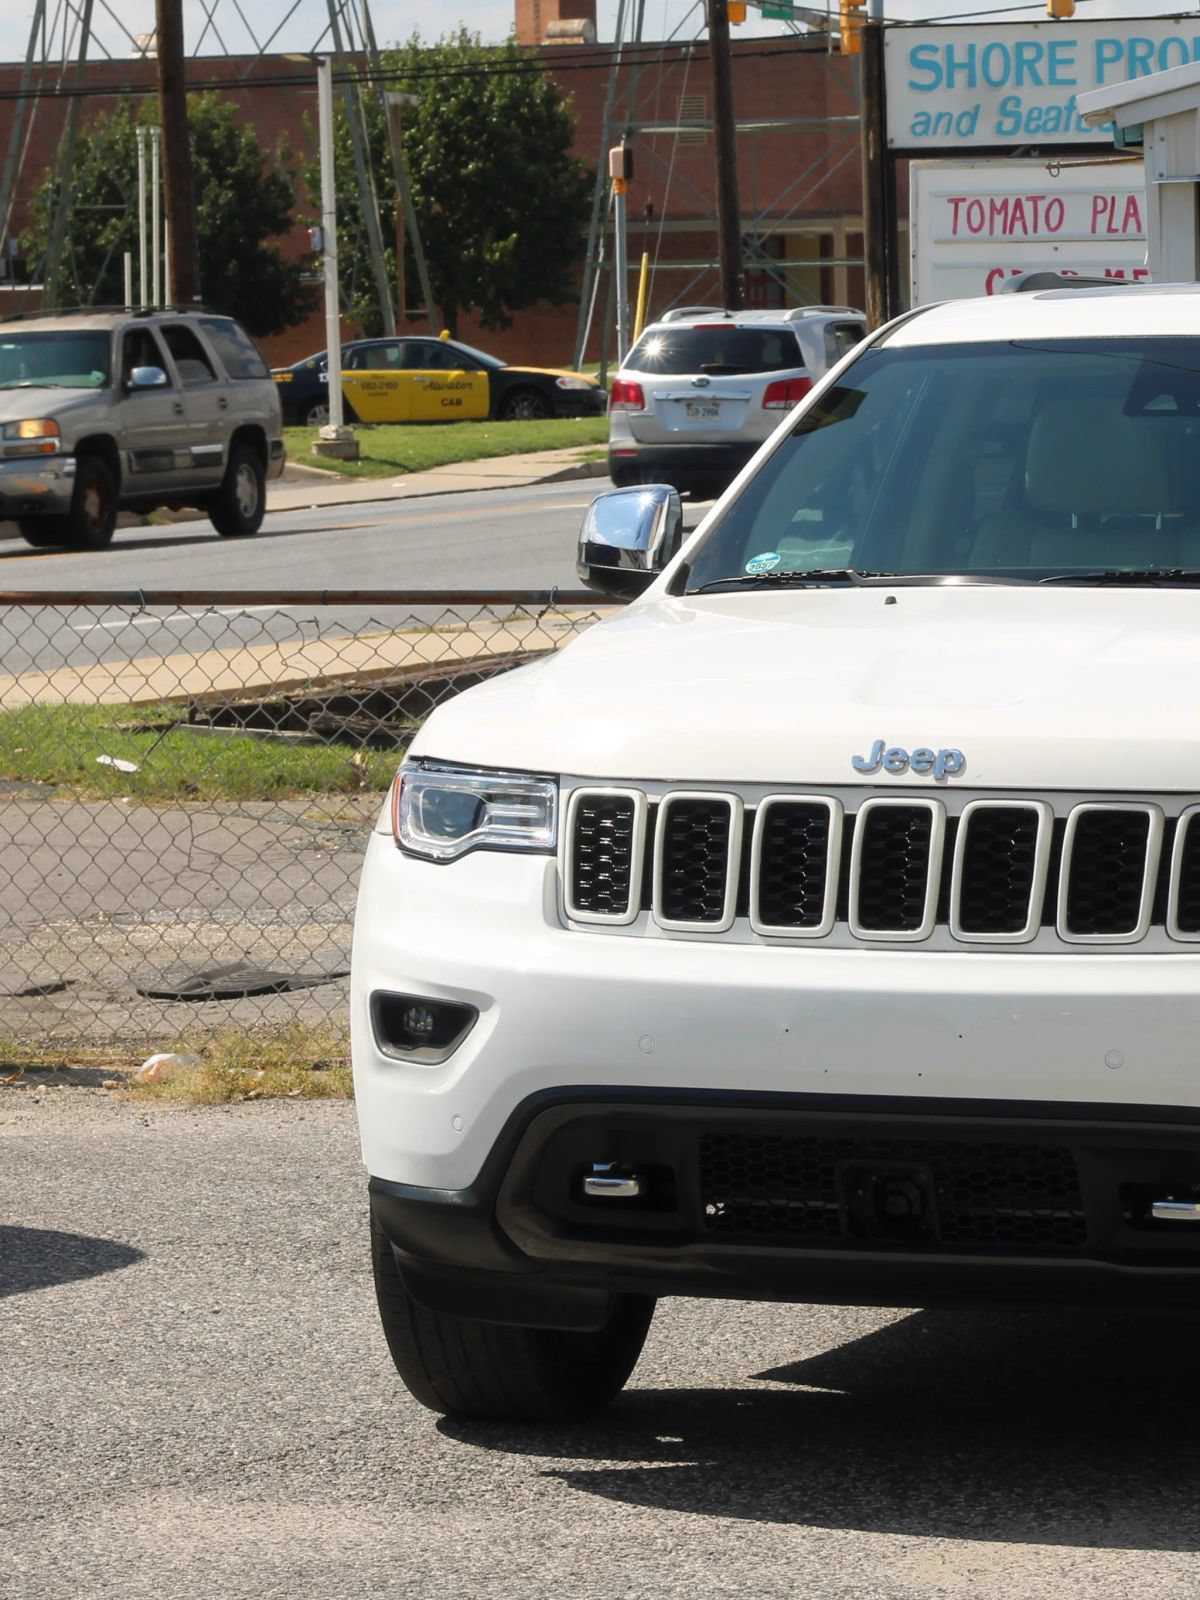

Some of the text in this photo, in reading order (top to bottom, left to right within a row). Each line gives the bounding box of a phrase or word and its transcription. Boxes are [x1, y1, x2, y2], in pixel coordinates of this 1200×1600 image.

[908, 39, 1078, 92] SHORE
[910, 103, 981, 137] and
[947, 194, 1142, 236] TOMATO PLA
[440, 397, 463, 408] CAB
[851, 739, 966, 780] Jeep
